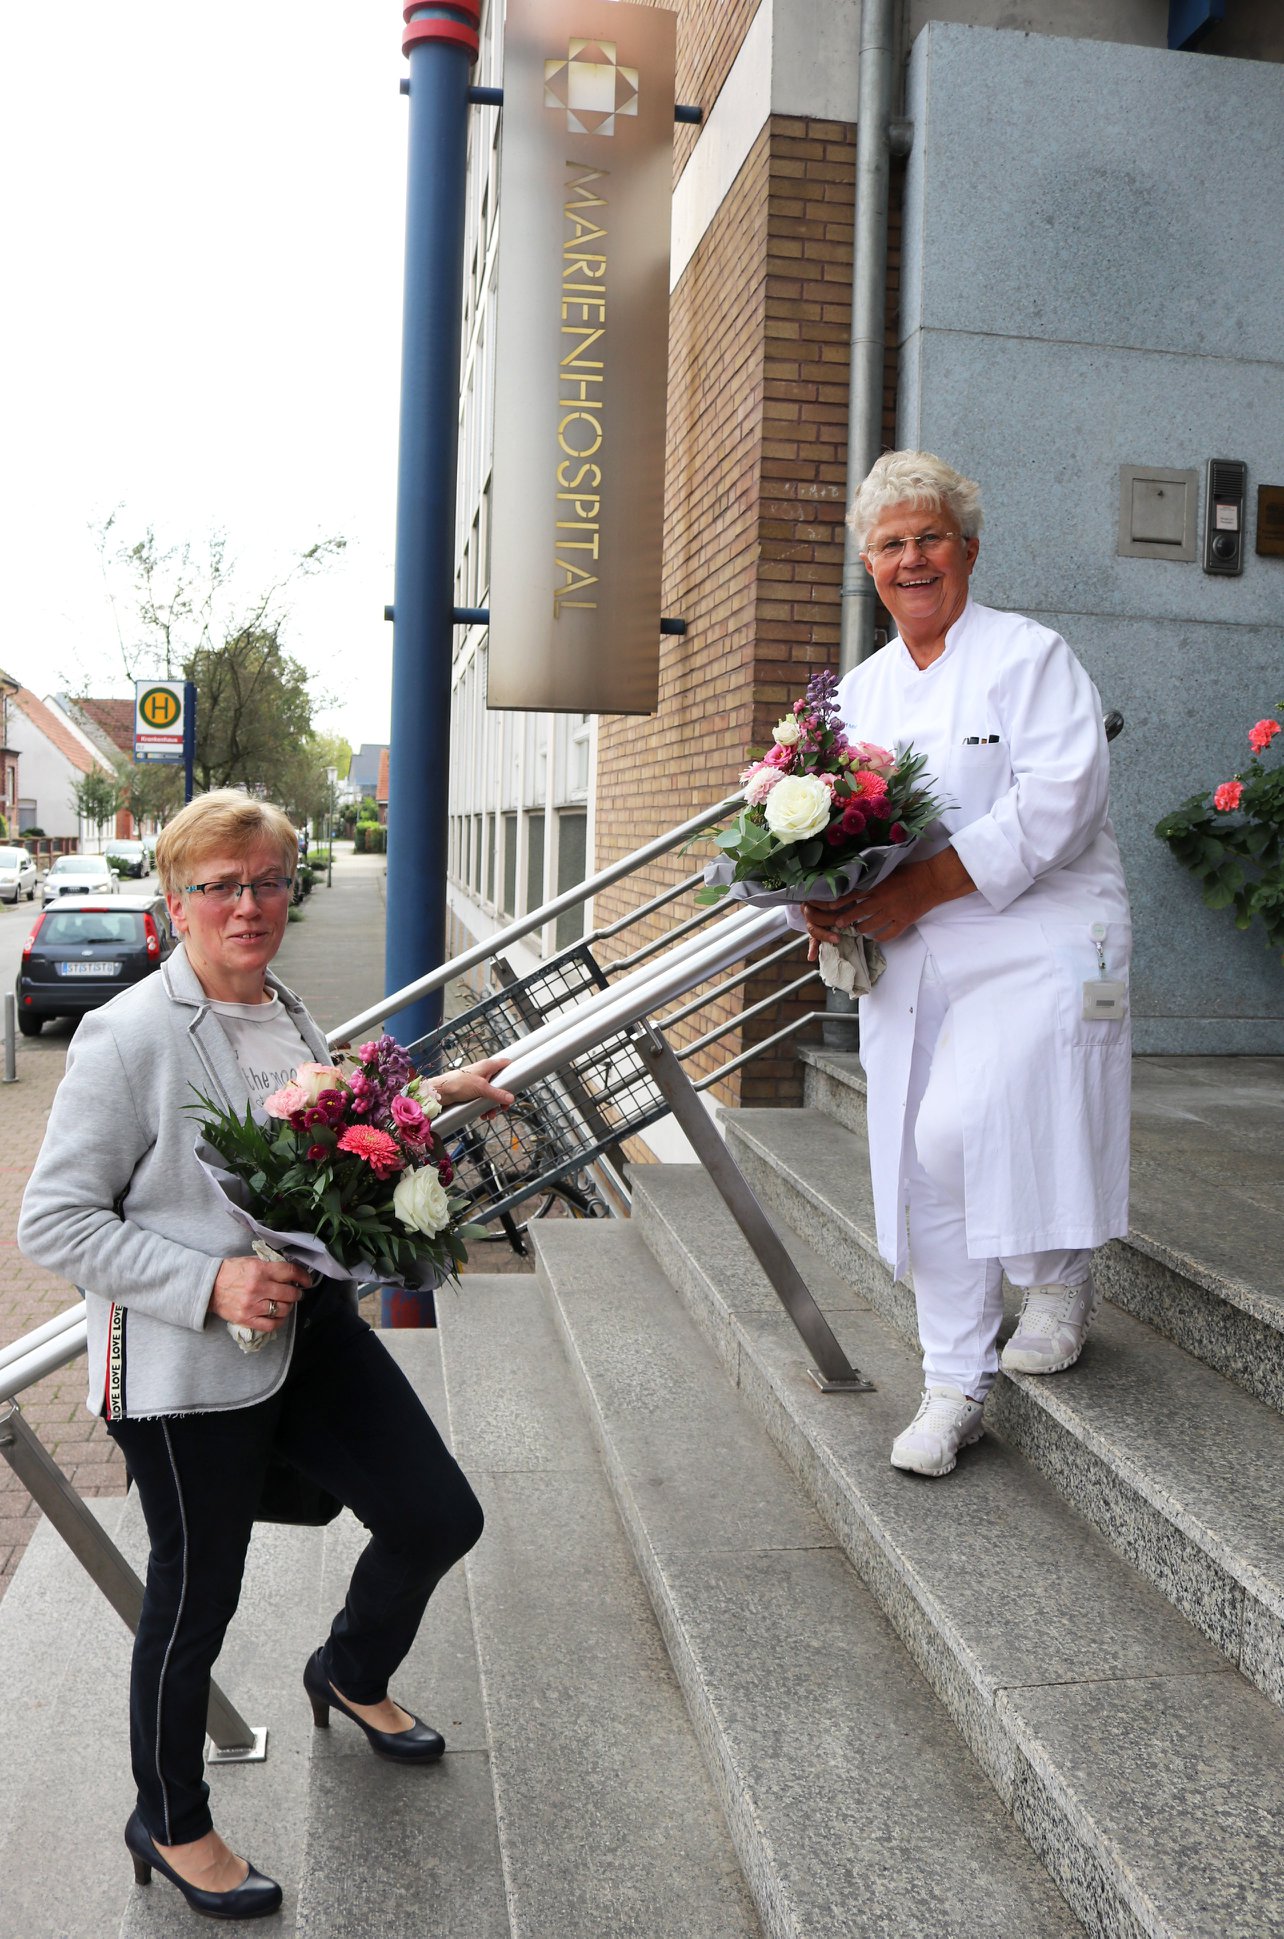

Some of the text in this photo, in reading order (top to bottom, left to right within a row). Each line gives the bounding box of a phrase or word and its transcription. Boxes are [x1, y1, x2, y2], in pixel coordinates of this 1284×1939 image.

[553, 160, 609, 619] MARIENHOSPITAL
[152, 696, 168, 719] H
[140, 735, 178, 743] Krankenhaus
[241, 1067, 270, 1091] the
[112, 1305, 122, 1418] LOVE LOVE LOVE LOVE
